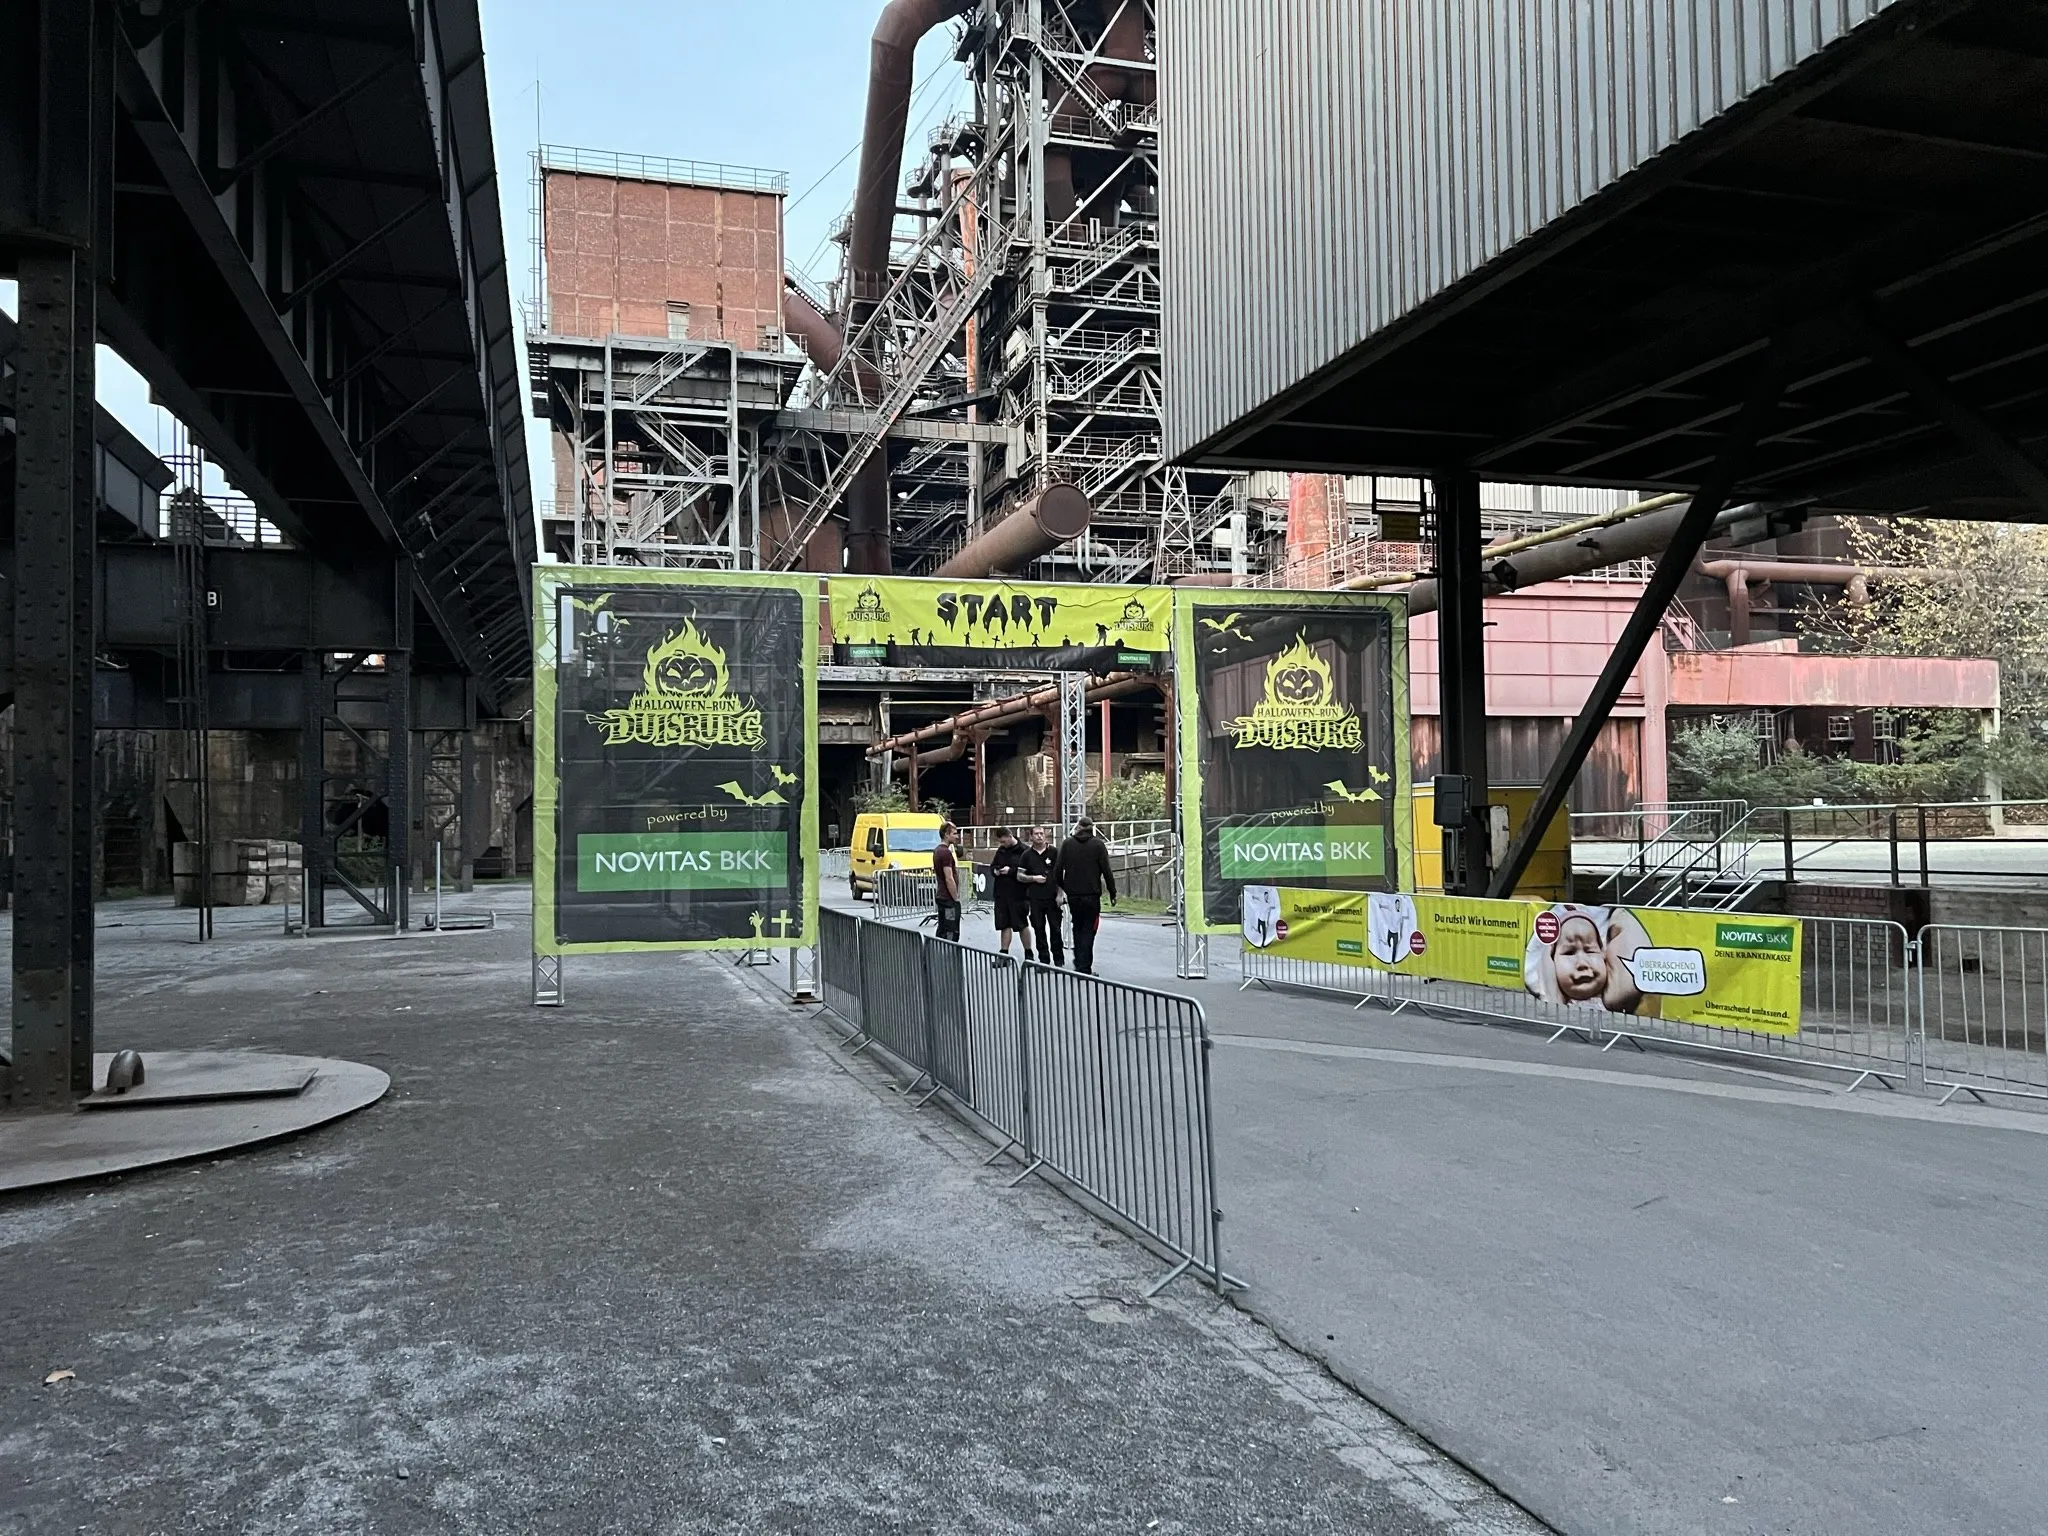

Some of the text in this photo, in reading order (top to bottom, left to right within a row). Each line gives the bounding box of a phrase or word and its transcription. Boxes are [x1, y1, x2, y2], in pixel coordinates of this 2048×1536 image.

[207, 591, 217, 607] B
[936, 592, 1058, 636] START
[634, 699, 736, 712] HALLOWEEN-RUN
[1256, 707, 1339, 718] HALLOWEEN-RUN
[596, 708, 766, 749] DUISBURG
[1230, 714, 1364, 751] DUISBURG
[646, 804, 728, 830] powered by
[1271, 801, 1335, 825] powered by
[1233, 841, 1372, 862] NOVITAS BKK
[595, 849, 772, 873] NOVITAS BKK
[1434, 913, 1520, 929] Du rufst? Wir kommen!
[1721, 930, 1788, 945] NOVITAS BKK
[1639, 959, 1696, 970] ÜBERRASCHEND
[1714, 950, 1792, 963] DEINE KRANKENKASSE
[1642, 970, 1699, 984] FÜRSORGT!
[1705, 1000, 1750, 1014] Überraschend
